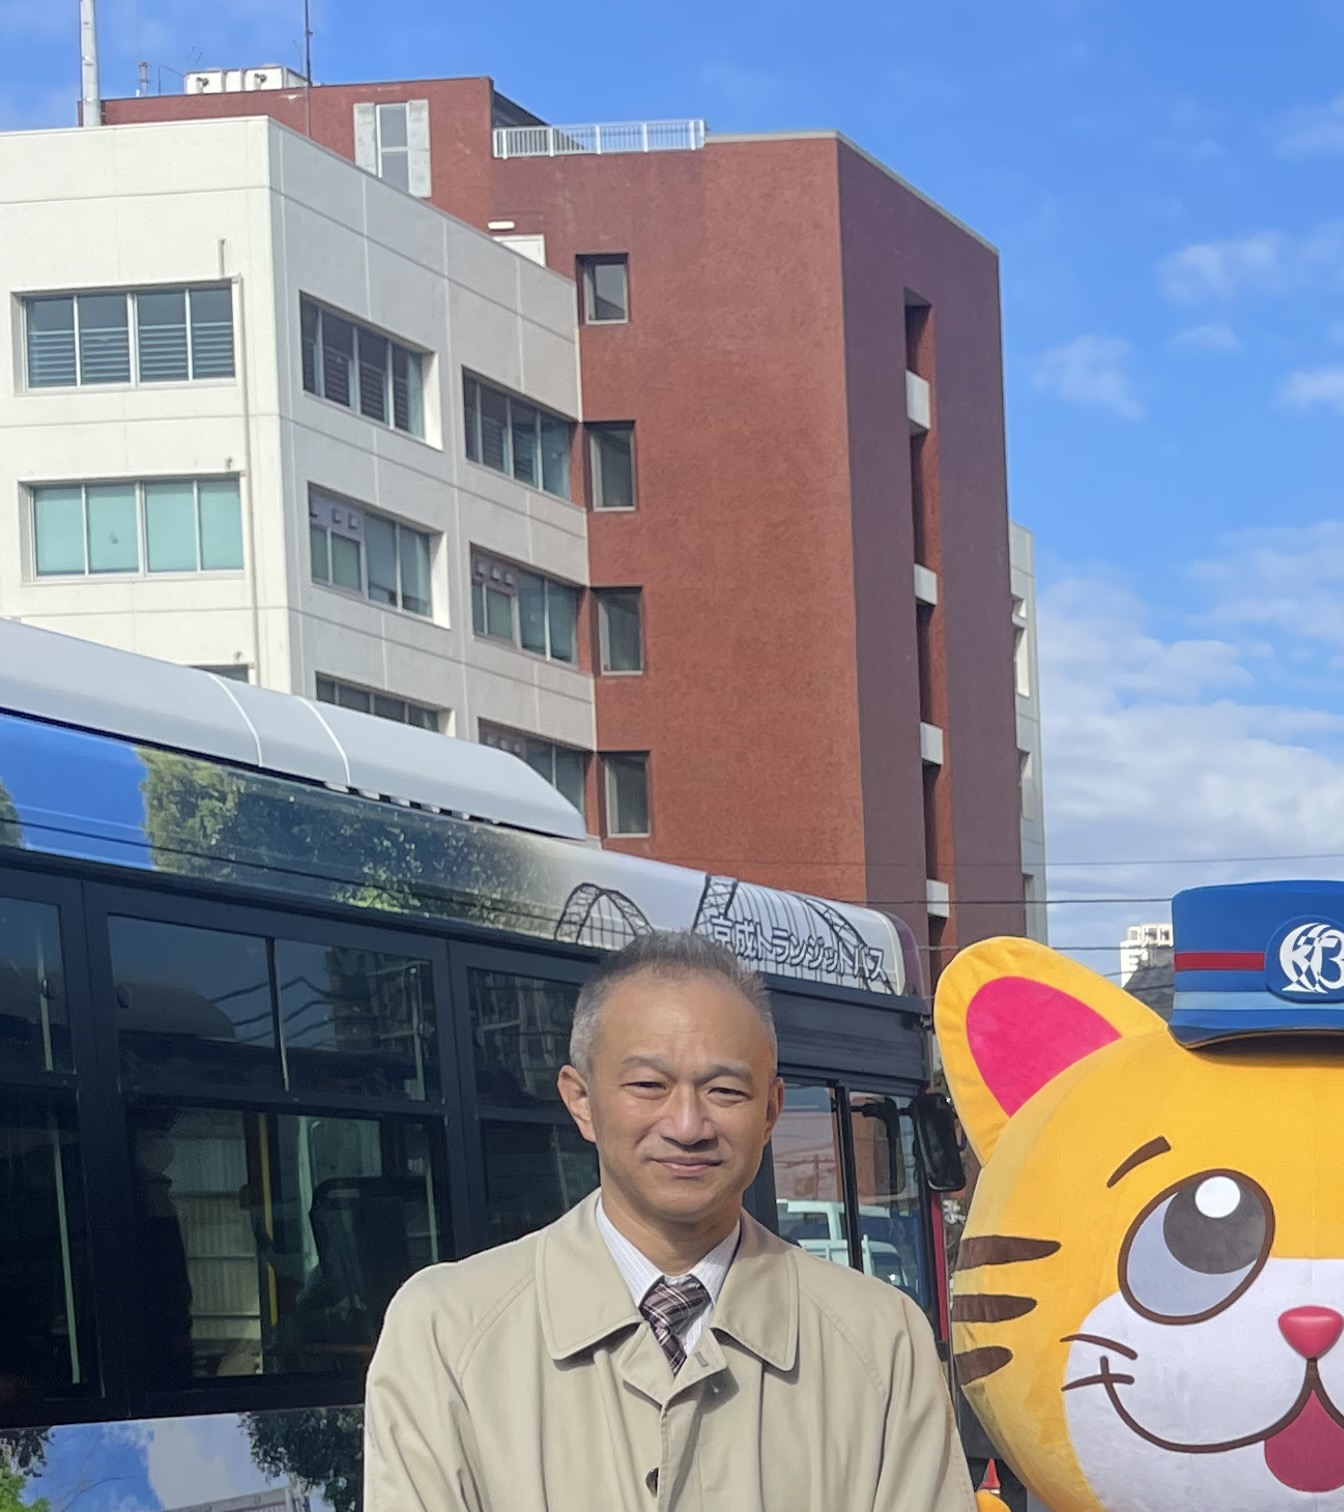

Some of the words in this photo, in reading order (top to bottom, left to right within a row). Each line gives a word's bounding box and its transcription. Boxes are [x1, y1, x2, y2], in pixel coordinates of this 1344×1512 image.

[709, 912, 888, 982] 京成トランジットバス
